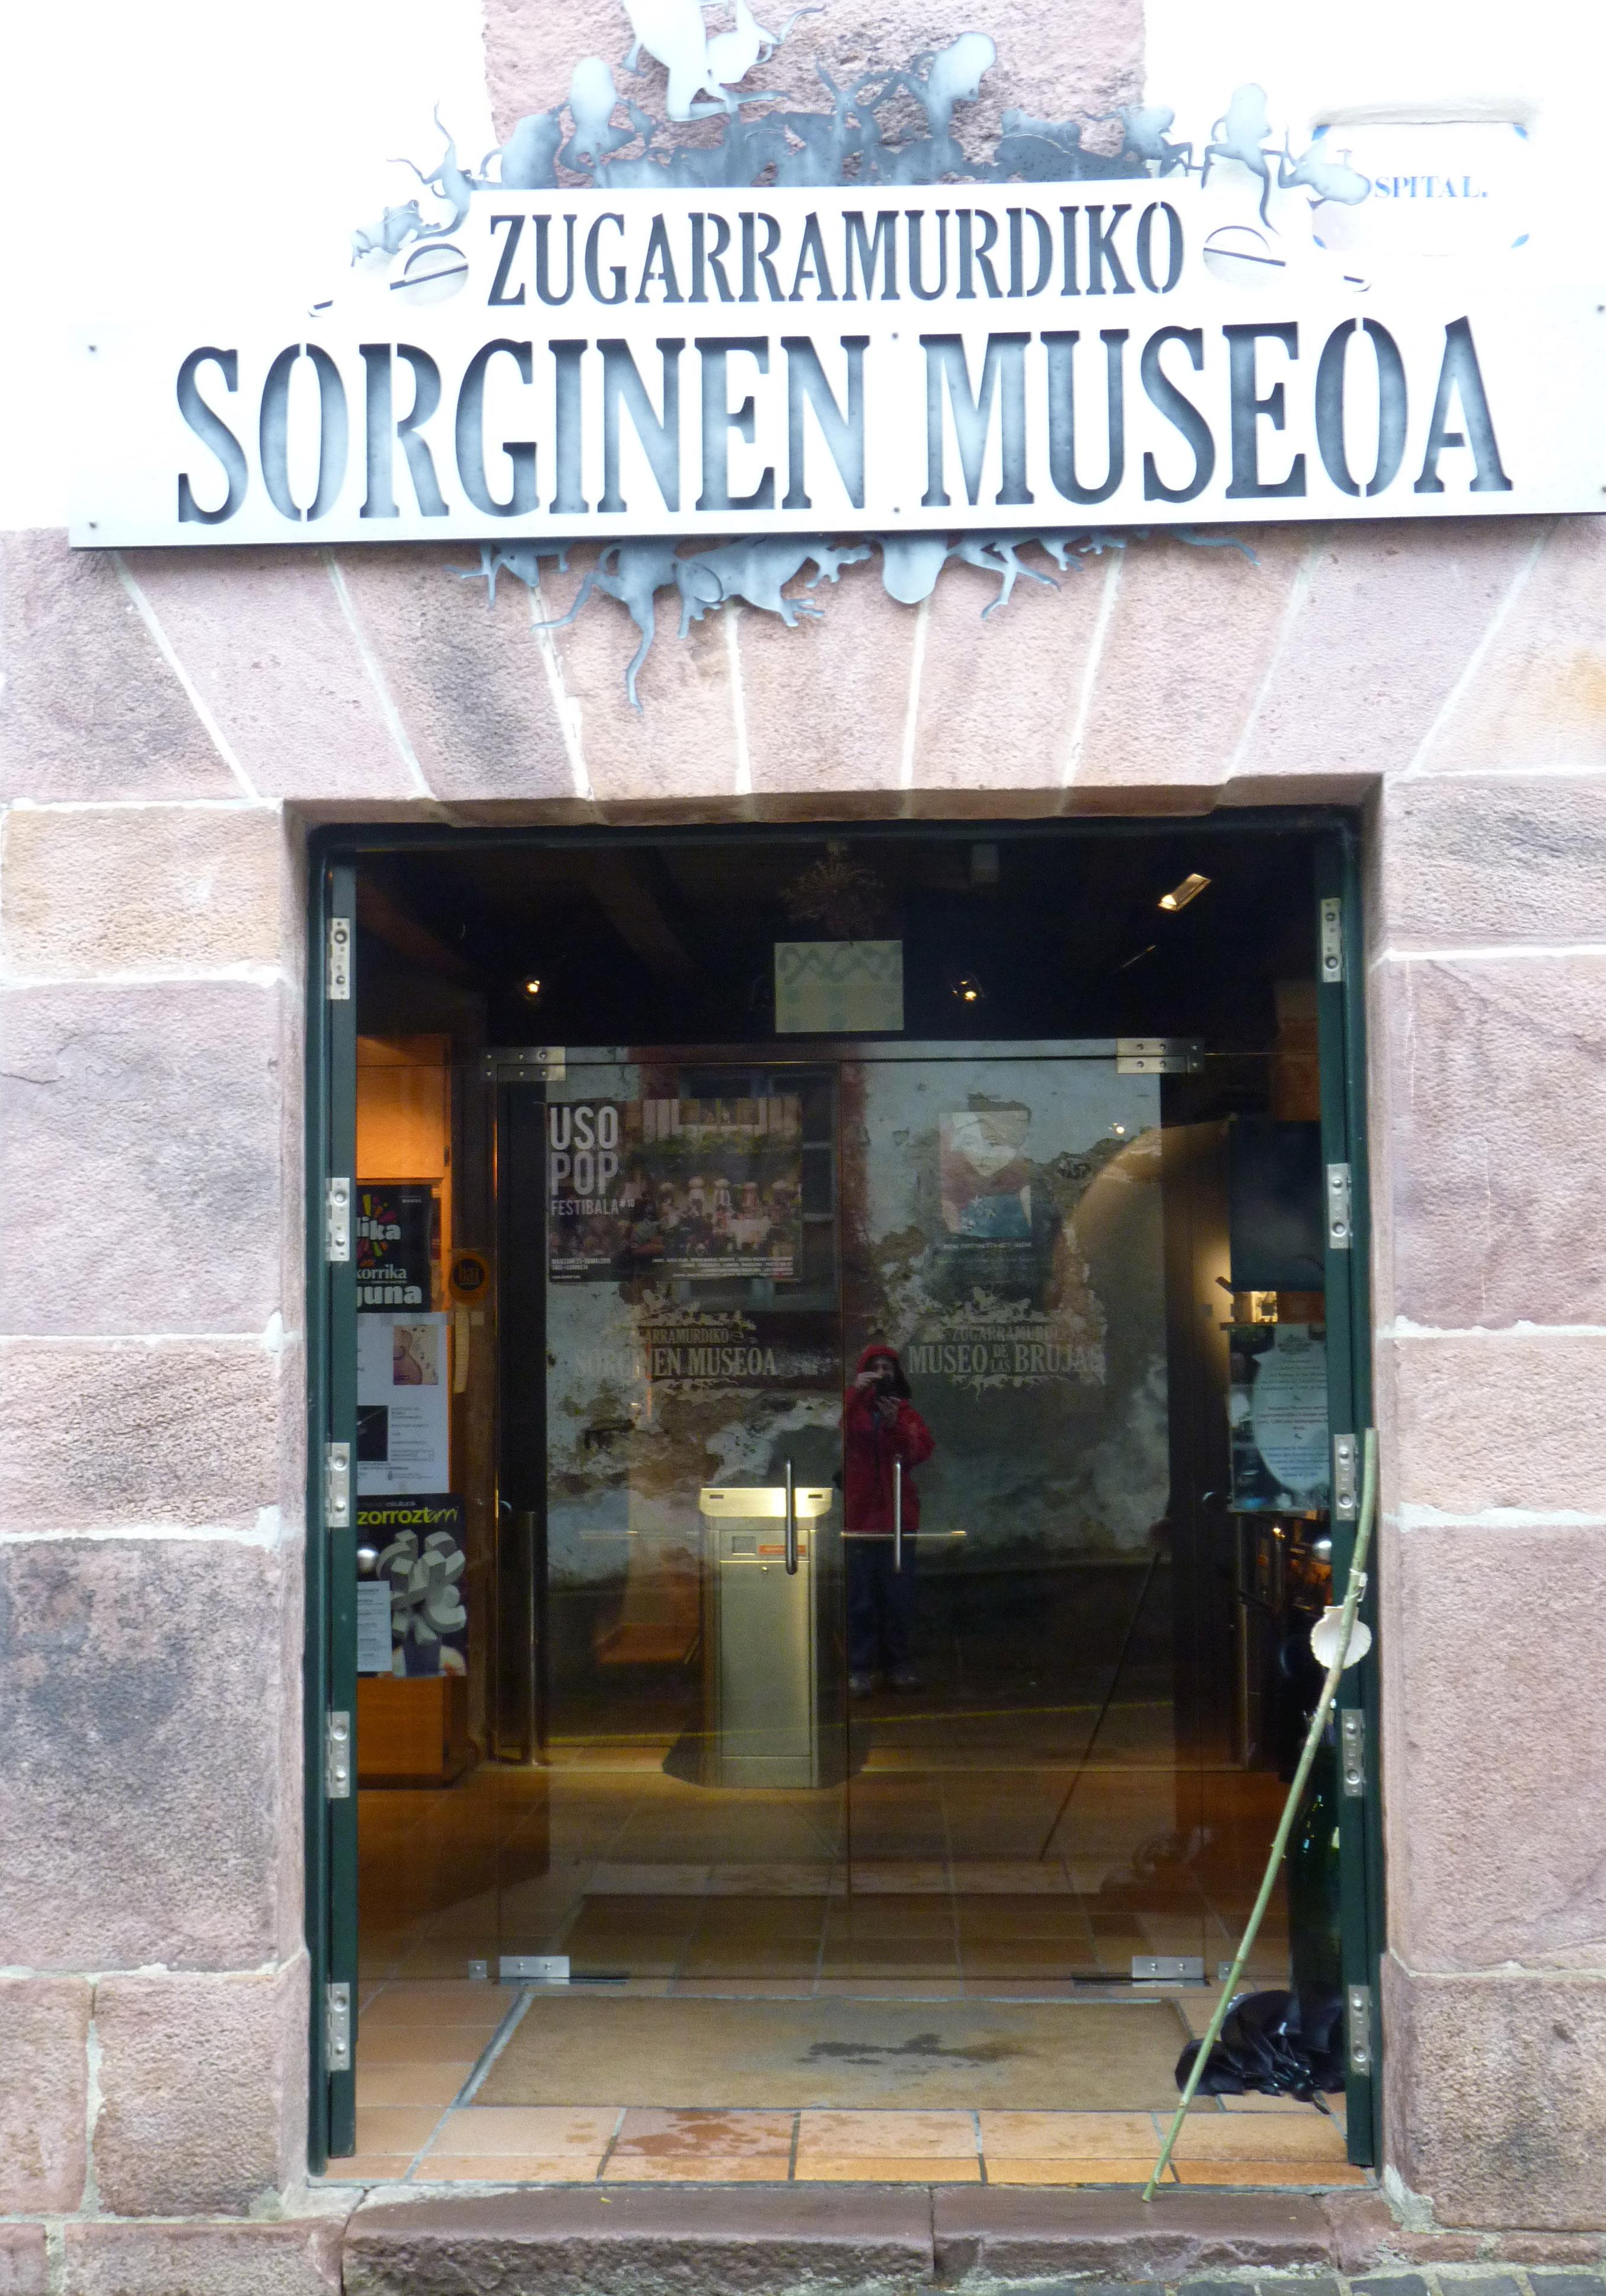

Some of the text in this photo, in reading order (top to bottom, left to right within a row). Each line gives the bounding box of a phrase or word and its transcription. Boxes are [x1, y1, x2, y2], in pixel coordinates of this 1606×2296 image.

[1371, 176, 1489, 197] SPITAL.
[488, 201, 1184, 306] ZUGARRAMURDIKO
[177, 315, 1514, 525] SORGINEN MUSEOA
[550, 1106, 618, 1150] USO
[550, 1152, 618, 1195] POP
[551, 1199, 619, 1215] FESTIBALA
[688, 1347, 778, 1376] MUSEOA
[908, 1345, 989, 1374] MUSEO
